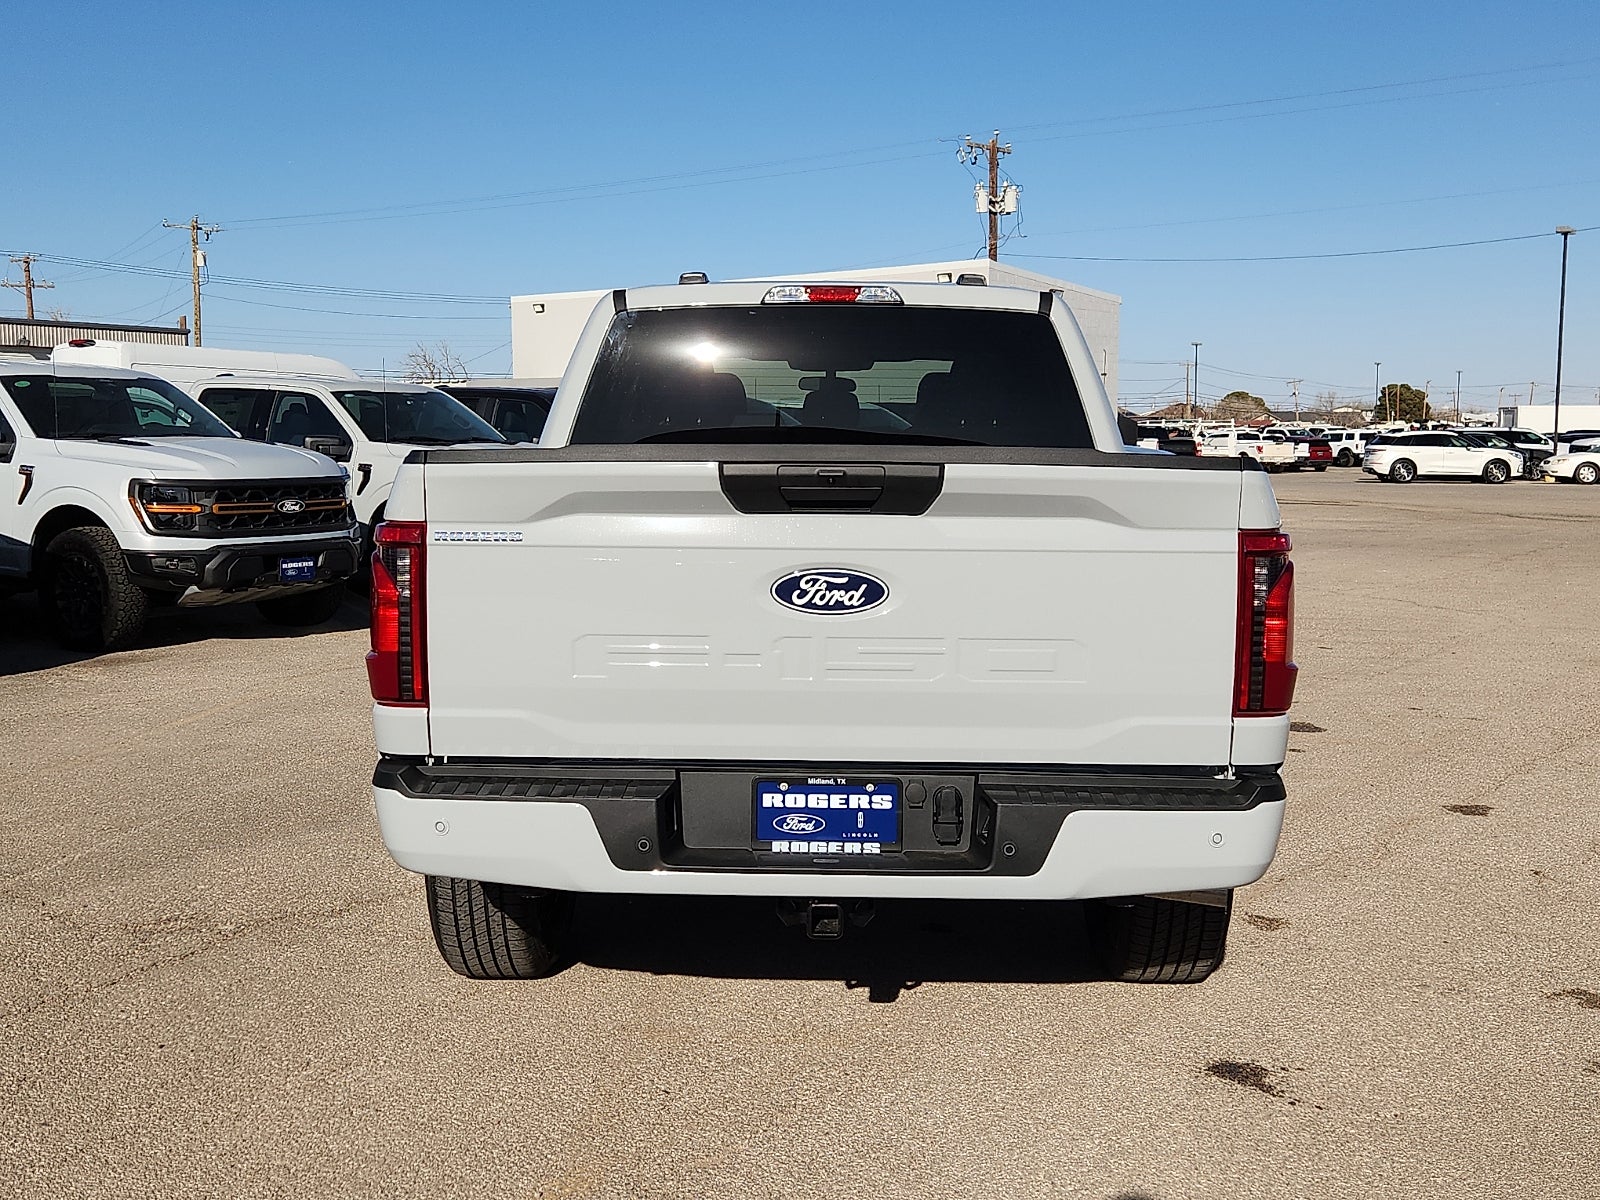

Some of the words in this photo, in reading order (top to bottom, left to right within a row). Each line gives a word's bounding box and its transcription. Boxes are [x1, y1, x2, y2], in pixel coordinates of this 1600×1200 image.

[282, 561, 314, 569] ROGERS
[791, 575, 868, 607] Ford
[572, 634, 1088, 684] F-150
[807, 777, 836, 786] Midland,
[762, 792, 893, 810] ROGERS
[771, 840, 881, 854] ROGERS
